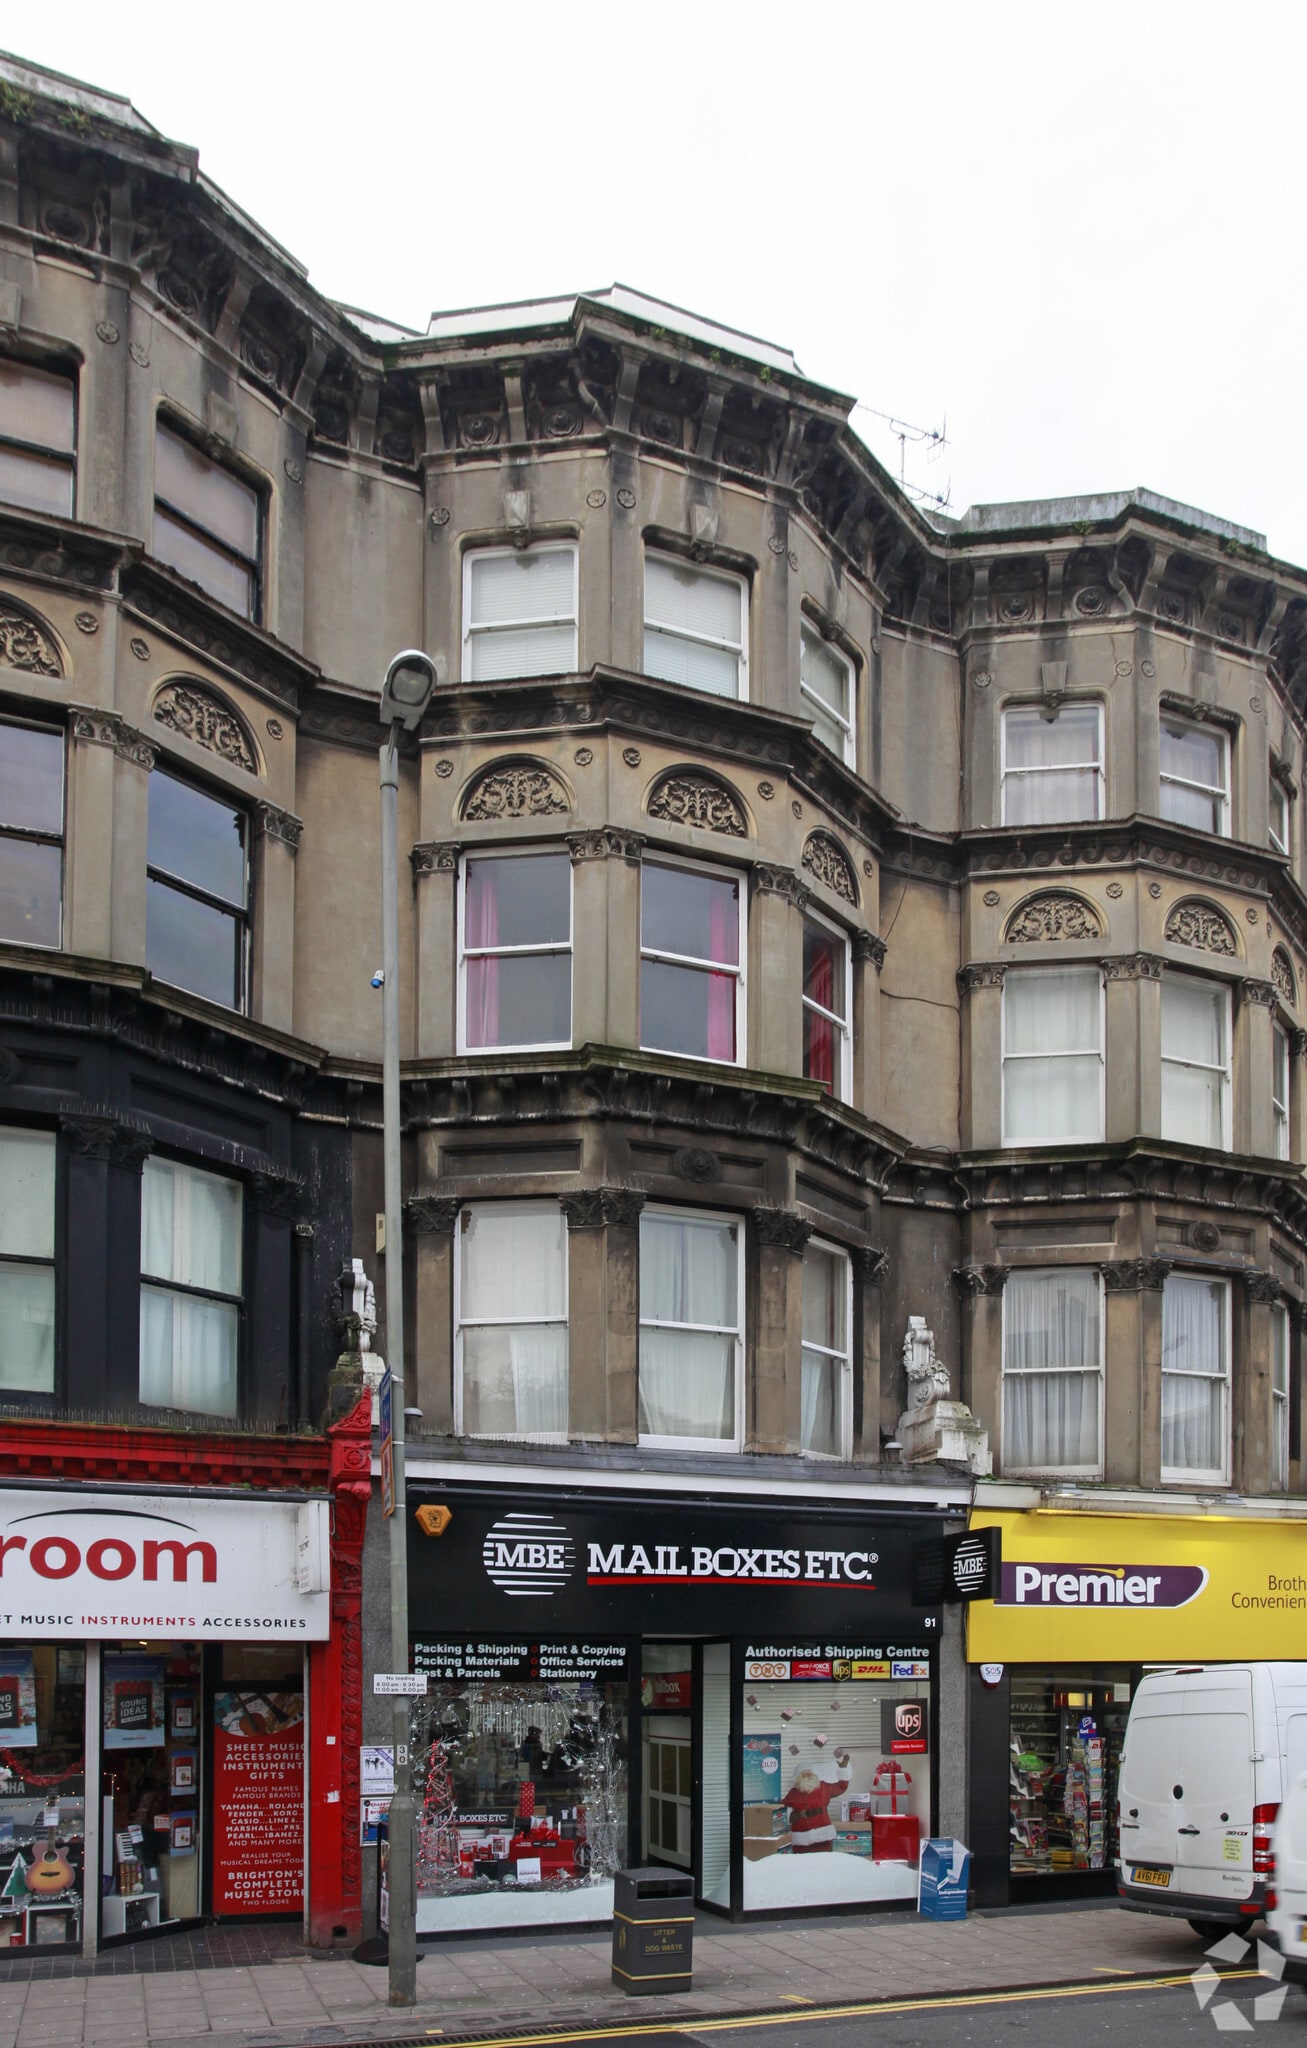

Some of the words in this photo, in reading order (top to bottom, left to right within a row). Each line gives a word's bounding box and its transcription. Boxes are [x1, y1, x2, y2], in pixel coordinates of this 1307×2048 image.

[495, 1542, 565, 1569] MBE
[587, 1543, 687, 1575] MAIL
[691, 1547, 800, 1578] BOXES
[957, 1556, 984, 1575] MBE
[1015, 1566, 1161, 1603] Premier
[1268, 1575, 1306, 1591] Broth
[1231, 1592, 1306, 1609] Convenien
[21, 1614, 73, 1625] MUSIC
[81, 1615, 196, 1626] INSTRUMENTS
[202, 1617, 306, 1628] ACCESSORIES
[924, 1618, 936, 1627] 91
[414, 1643, 462, 1654] Packing
[465, 1644, 474, 1653] &
[477, 1644, 528, 1655] Shipping
[539, 1645, 568, 1654] Print
[570, 1645, 580, 1654] &
[582, 1645, 626, 1656] Copying
[745, 1646, 820, 1657] Authorised
[825, 1646, 882, 1659] Shipping
[886, 1646, 930, 1657] Centre
[414, 1656, 462, 1667] Packing
[465, 1656, 520, 1665] Materials
[539, 1657, 574, 1666] Office
[576, 1657, 624, 1666] Services
[414, 1668, 441, 1677] Post
[445, 1668, 454, 1677] &
[457, 1668, 501, 1677] Parcels
[539, 1668, 597, 1679] Stationery
[751, 1664, 785, 1676] TNT
[857, 1665, 885, 1673] DHL
[893, 1664, 927, 1676] FedEx
[985, 1667, 1001, 1675] SOS
[120, 1697, 147, 1709] SOUND
[120, 1705, 147, 1717] IDEAS
[226, 1743, 264, 1752] SHEET
[223, 1762, 304, 1771] INSTRUMENT
[249, 1772, 284, 1780] GIFTS
[459, 1814, 488, 1823] BOXES
[228, 1870, 304, 1880] BRIGHTON'S
[234, 1879, 298, 1889] COMPLETE
[224, 1890, 264, 1900] MUSIC
[653, 1928, 675, 1936] LITTER
[661, 1943, 683, 1951] WASTE
